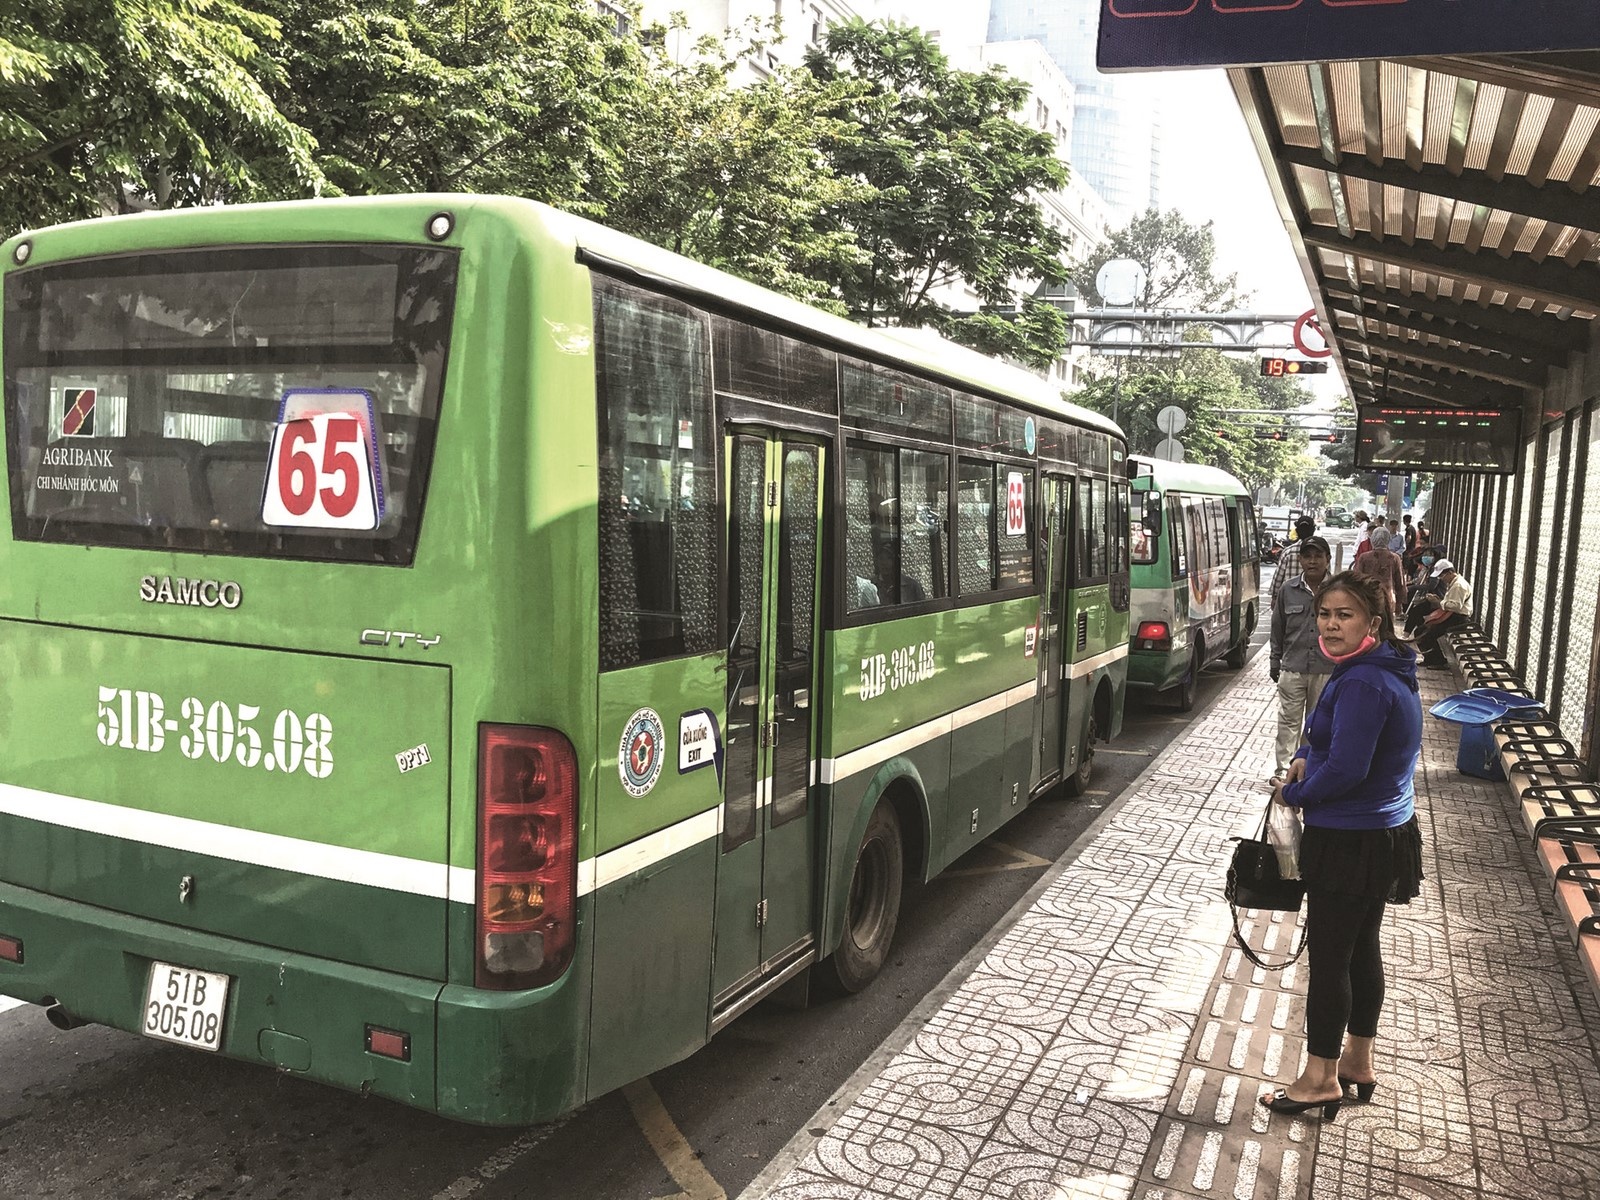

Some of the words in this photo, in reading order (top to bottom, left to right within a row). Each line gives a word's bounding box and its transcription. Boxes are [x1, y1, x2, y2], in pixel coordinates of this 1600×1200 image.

[1268, 359, 1283, 375] 19
[42, 447, 113, 467] AGRIBANK
[278, 418, 360, 518] 65
[36, 476, 50, 489] CHI
[51, 474, 79, 491] NHÁNH
[100, 476, 119, 492] MÔN
[1009, 482, 1023, 529] 65
[139, 576, 242, 609] SAMCO
[359, 628, 442, 650] CITY
[859, 640, 935, 701] 51B-305.08
[96, 685, 334, 778] 51B-305.08
[688, 748, 702, 763] EXIT
[166, 970, 207, 1005] 51B
[147, 1000, 219, 1044] 305.08
